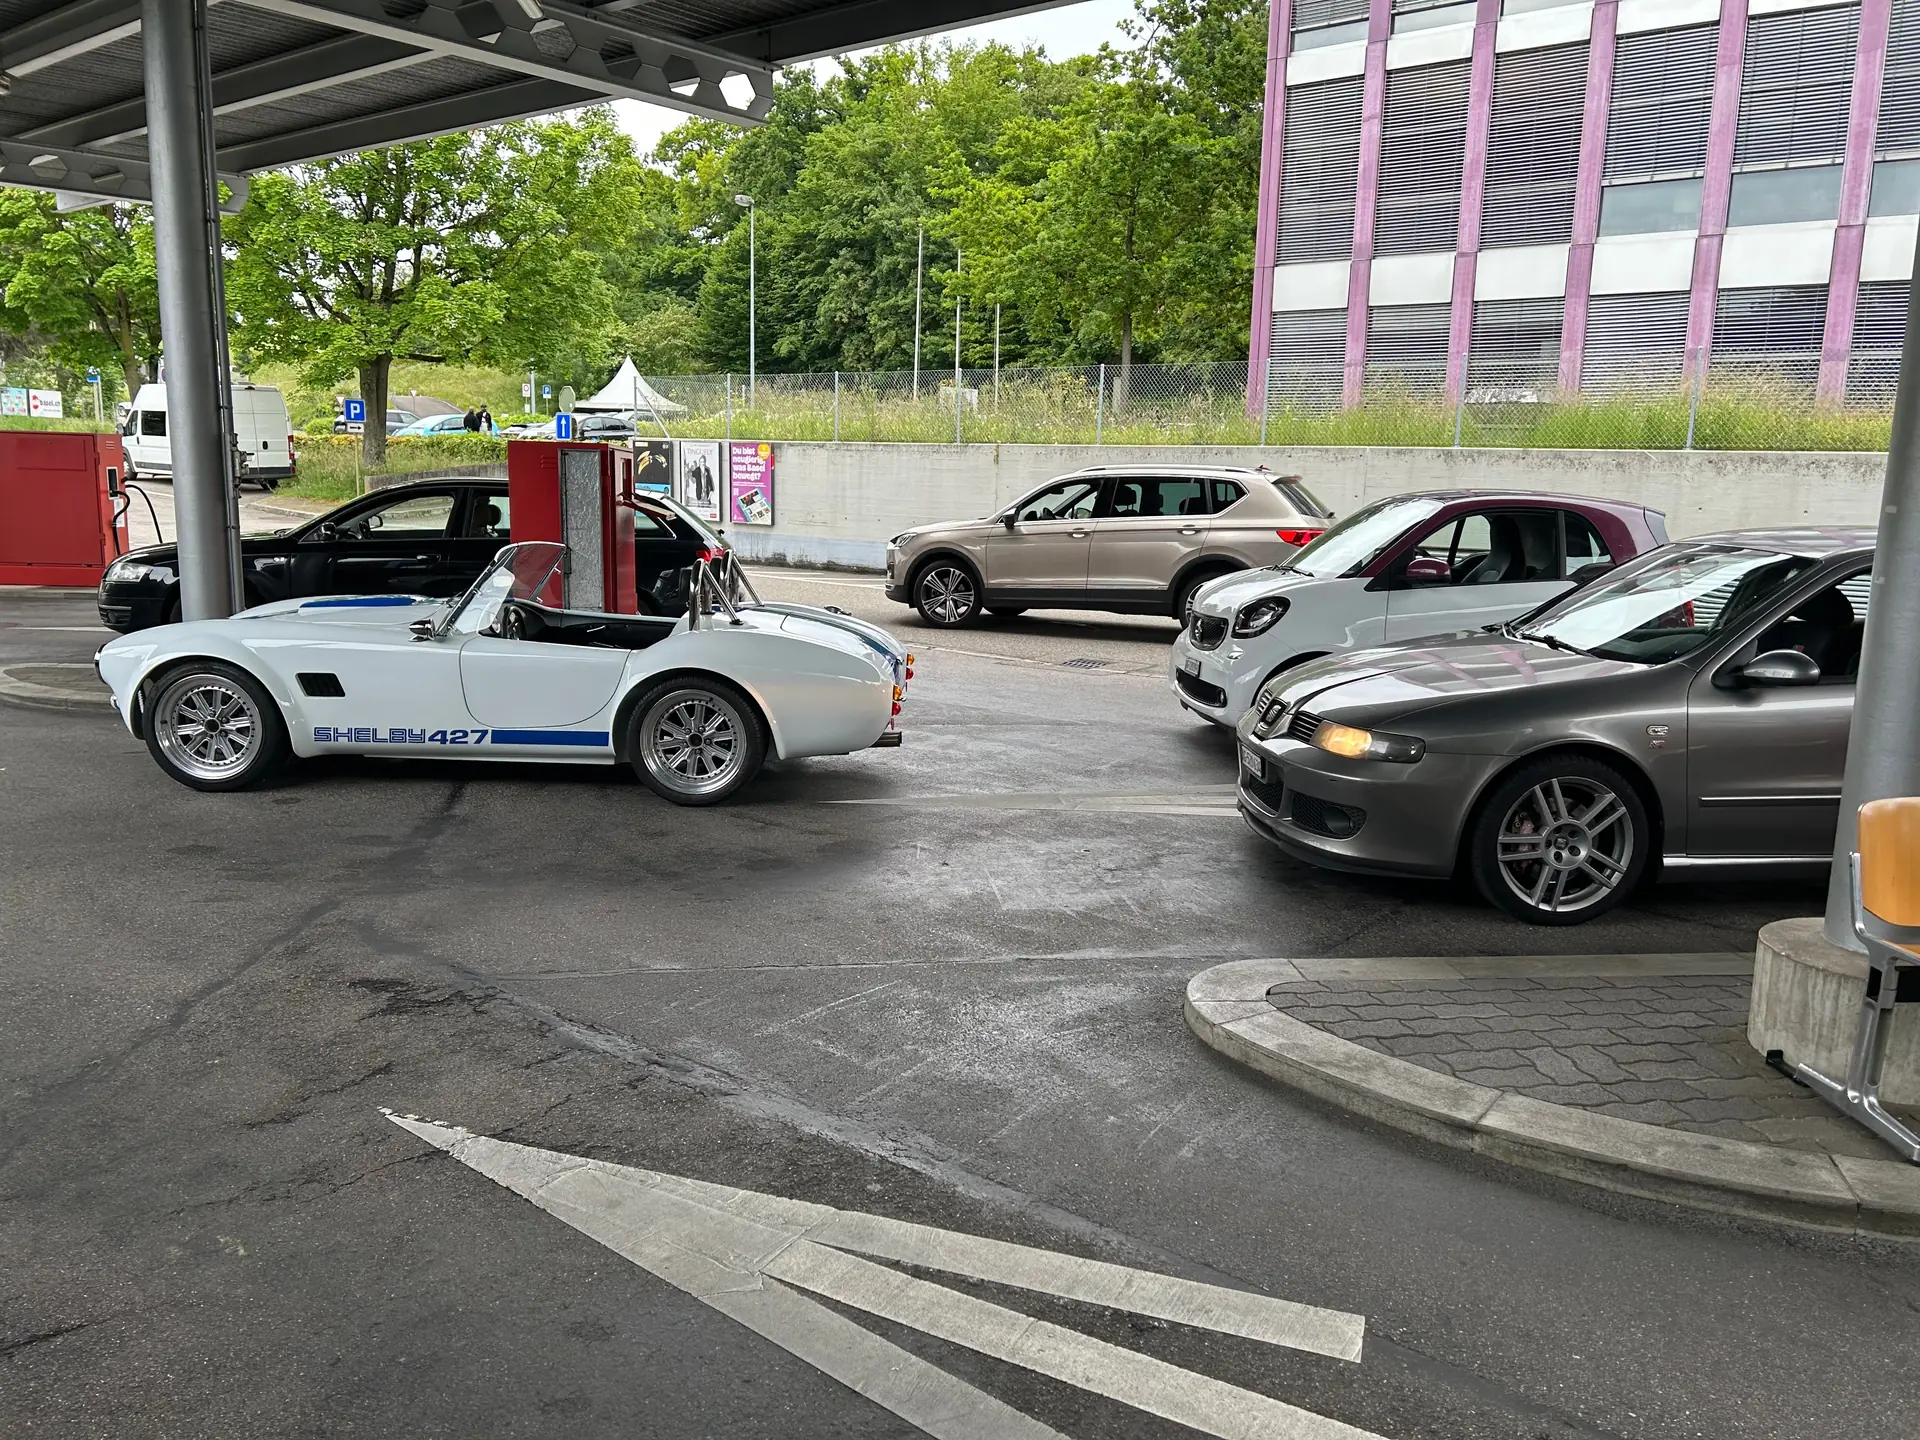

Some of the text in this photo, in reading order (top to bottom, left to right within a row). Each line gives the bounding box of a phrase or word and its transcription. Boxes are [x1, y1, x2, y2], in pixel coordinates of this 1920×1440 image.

[350, 403, 361, 419] P
[732, 447, 742, 455] Du
[742, 447, 755, 455] bist
[732, 461, 765, 472] was Basel
[732, 472, 761, 481] bewegt?
[314, 727, 488, 744] SHELBY 427
